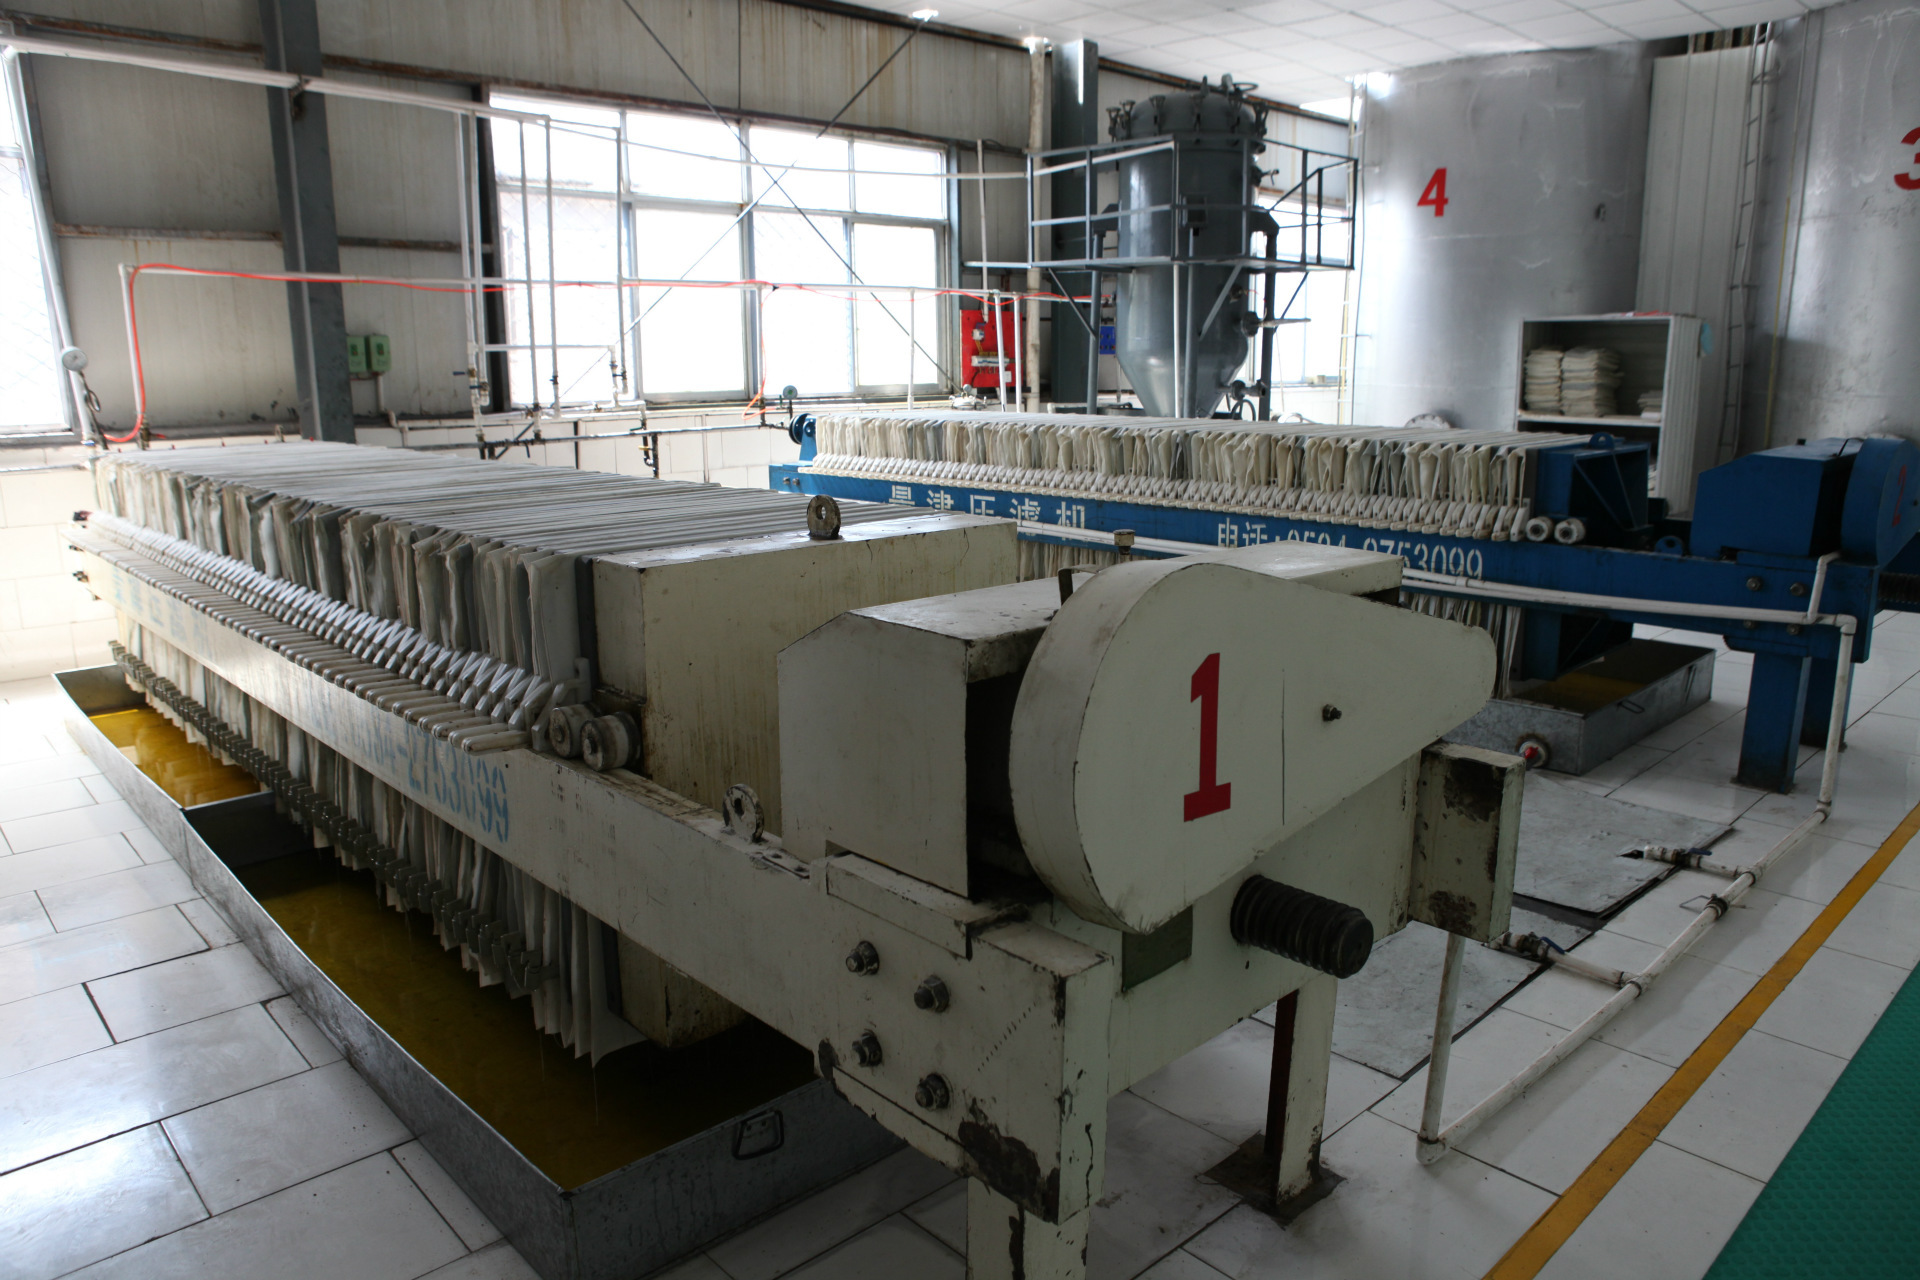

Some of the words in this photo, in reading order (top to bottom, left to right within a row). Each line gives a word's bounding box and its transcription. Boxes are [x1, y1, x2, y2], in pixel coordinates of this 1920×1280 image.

[1893, 126, 1920, 191] 3
[1417, 167, 1449, 217] 4
[1891, 464, 1907, 528] 2
[1183, 652, 1231, 822] 1
